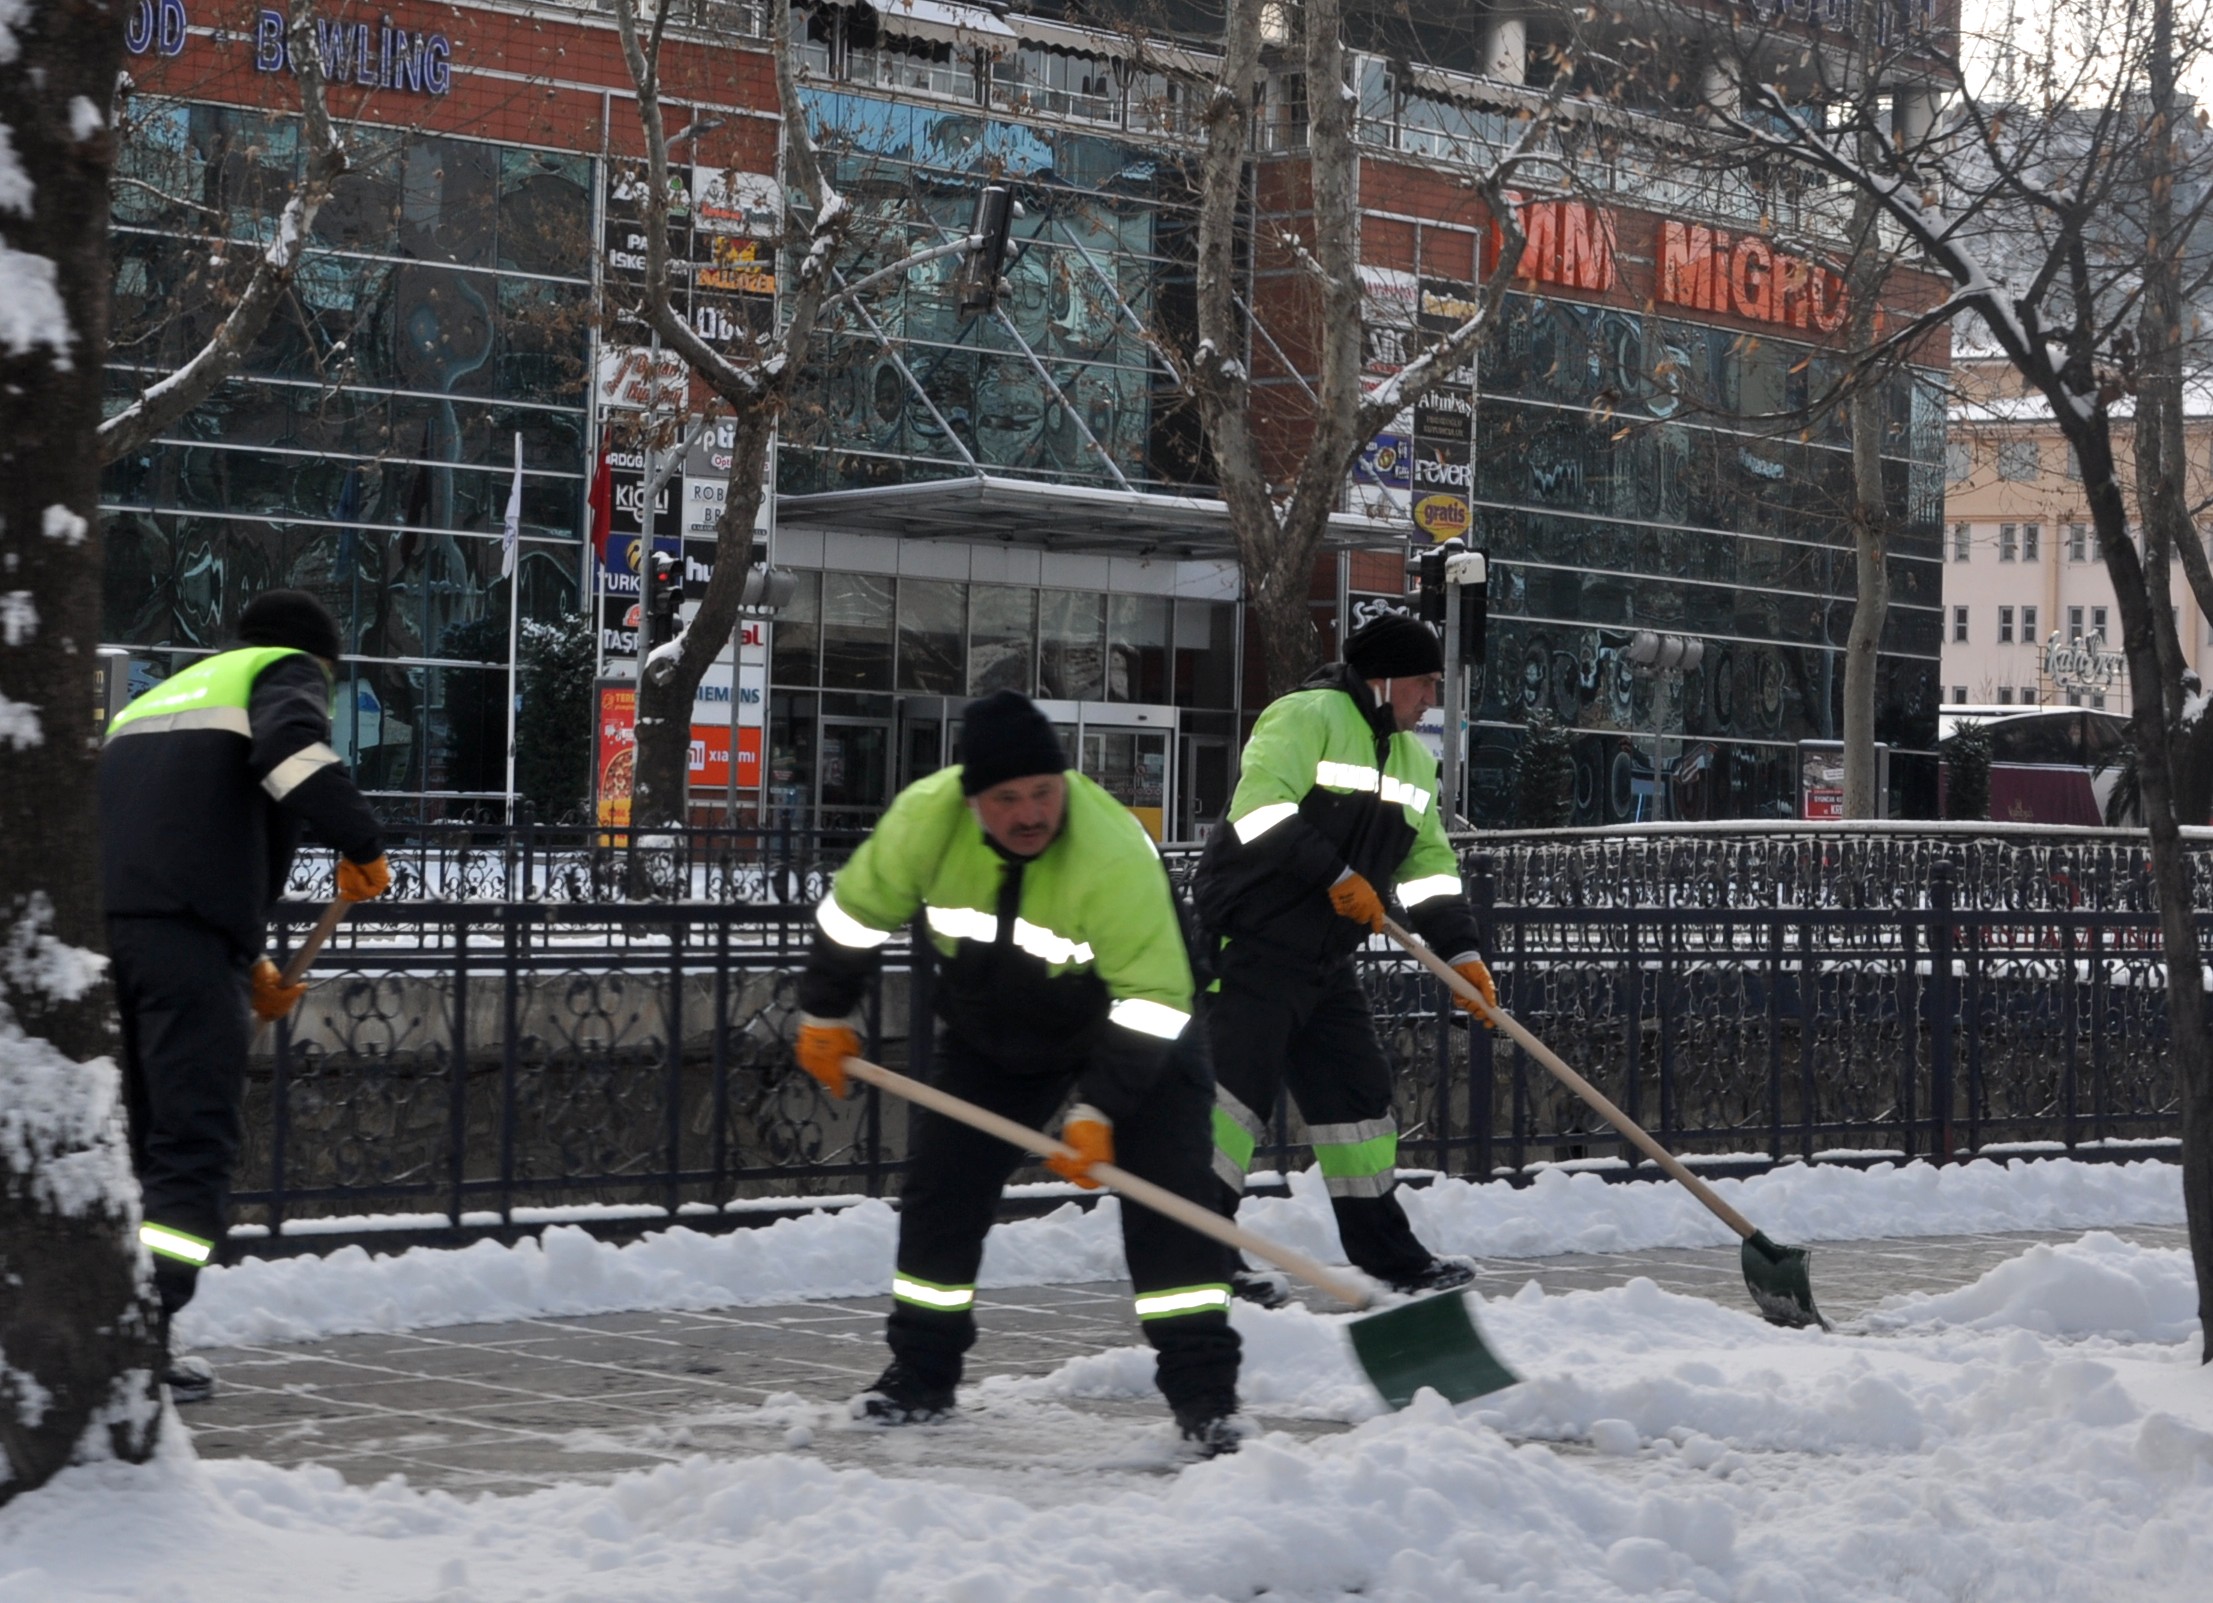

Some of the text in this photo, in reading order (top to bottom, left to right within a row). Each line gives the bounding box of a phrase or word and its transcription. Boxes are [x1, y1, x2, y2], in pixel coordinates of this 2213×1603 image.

[257, 9, 450, 95] BWLİNG
[1423, 502, 1466, 525] gratis
[708, 751, 755, 763] xiami
